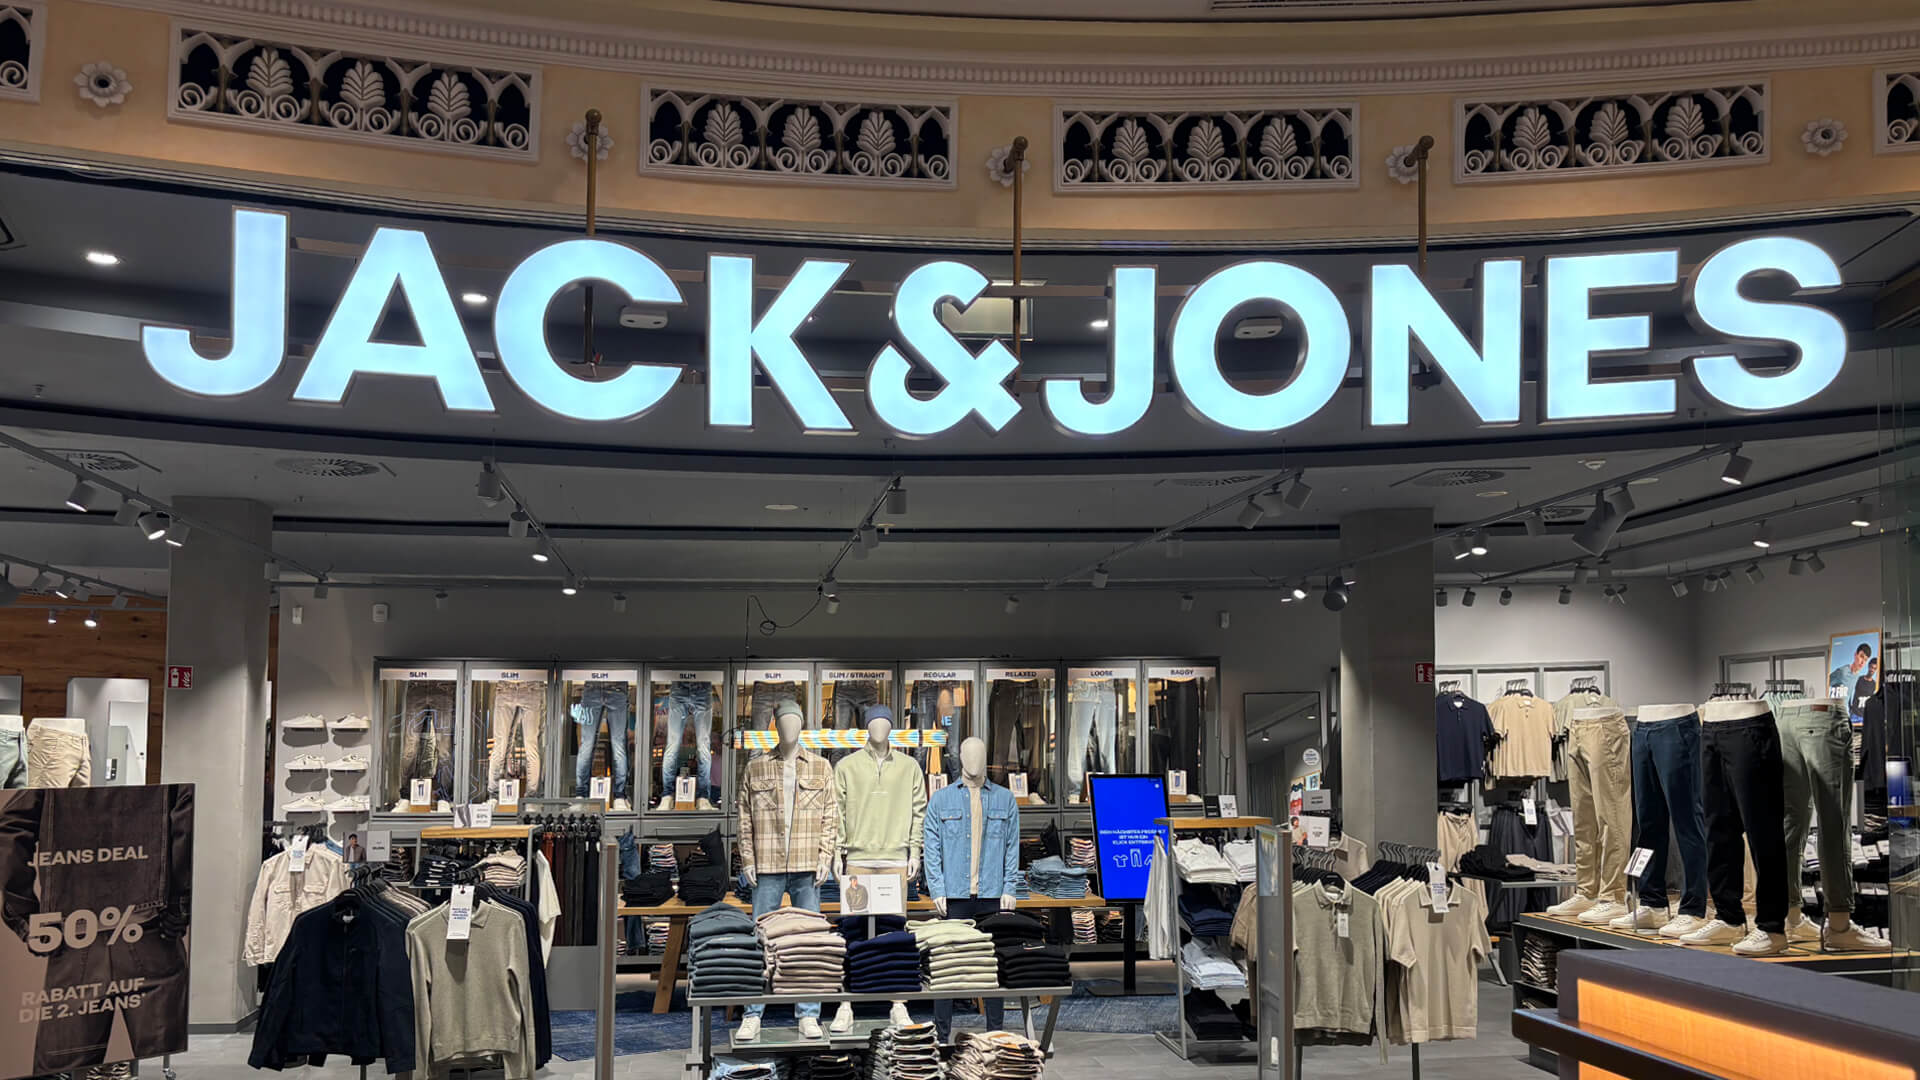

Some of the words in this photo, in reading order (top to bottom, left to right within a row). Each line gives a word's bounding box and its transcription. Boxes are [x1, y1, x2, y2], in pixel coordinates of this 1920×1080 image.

[28, 850, 94, 867] JEANS
[97, 847, 149, 863] DEAL
[28, 904, 144, 954] 50%
[22, 984, 102, 1006] RABATT
[106, 978, 145, 995] AUF
[19, 1005, 53, 1024] DIE
[57, 1003, 74, 1019] 2.
